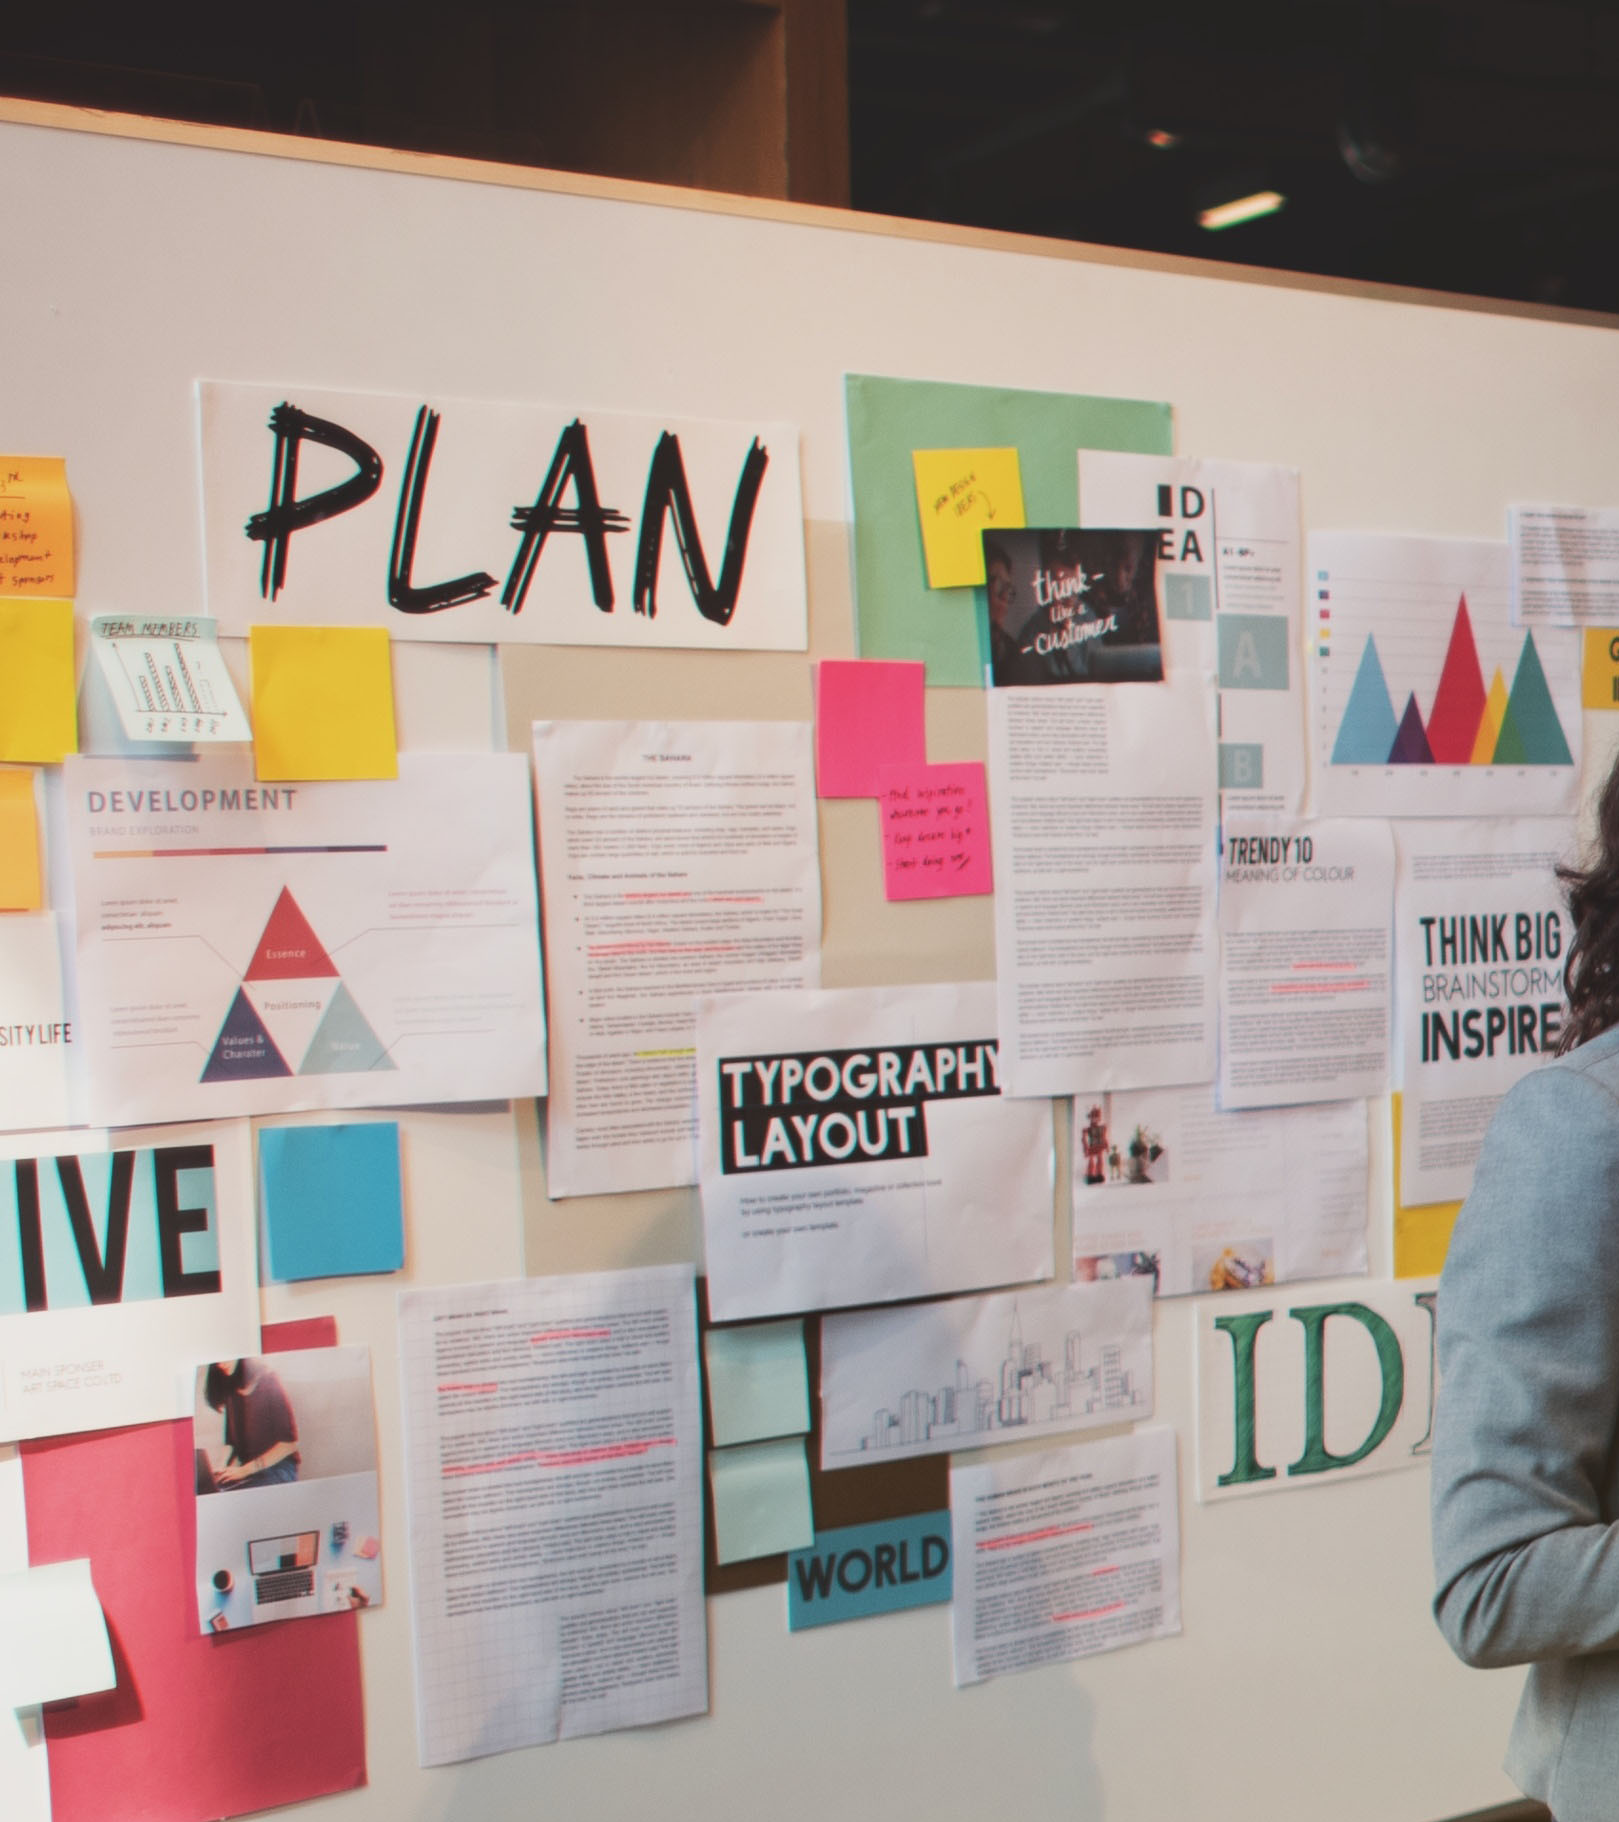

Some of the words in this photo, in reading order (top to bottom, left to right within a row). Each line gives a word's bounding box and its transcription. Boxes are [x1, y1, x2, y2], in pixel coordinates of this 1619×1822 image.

[245, 402, 769, 627] PLAN
[1157, 484, 1206, 519] ID
[1157, 528, 1204, 562] EA
[102, 621, 135, 637] TEAM
[142, 621, 198, 638] MEMBERS
[88, 787, 298, 814] DEVELOPMENT
[1228, 836, 1292, 865] TRENDY
[1294, 836, 1314, 864] 10
[1226, 869, 1278, 883] MEANING
[1281, 868, 1299, 882] OF
[1302, 866, 1354, 882] COLOUR
[265, 947, 307, 960] Essence
[1419, 913, 1508, 967] THINK
[1515, 911, 1562, 960] BIG
[1423, 968, 1563, 1004] BRAINSTORM
[263, 999, 322, 1013] Positioning
[39, 1022, 73, 1045] LIFE
[221, 1036, 253, 1048] Values
[1420, 1003, 1563, 1063] INSPIRE
[723, 1045, 1000, 1108] TYPOGRAPHY
[732, 1108, 918, 1170] LAYOUT
[14, 1144, 222, 1312] IVE
[794, 1533, 949, 1603] WORLD
